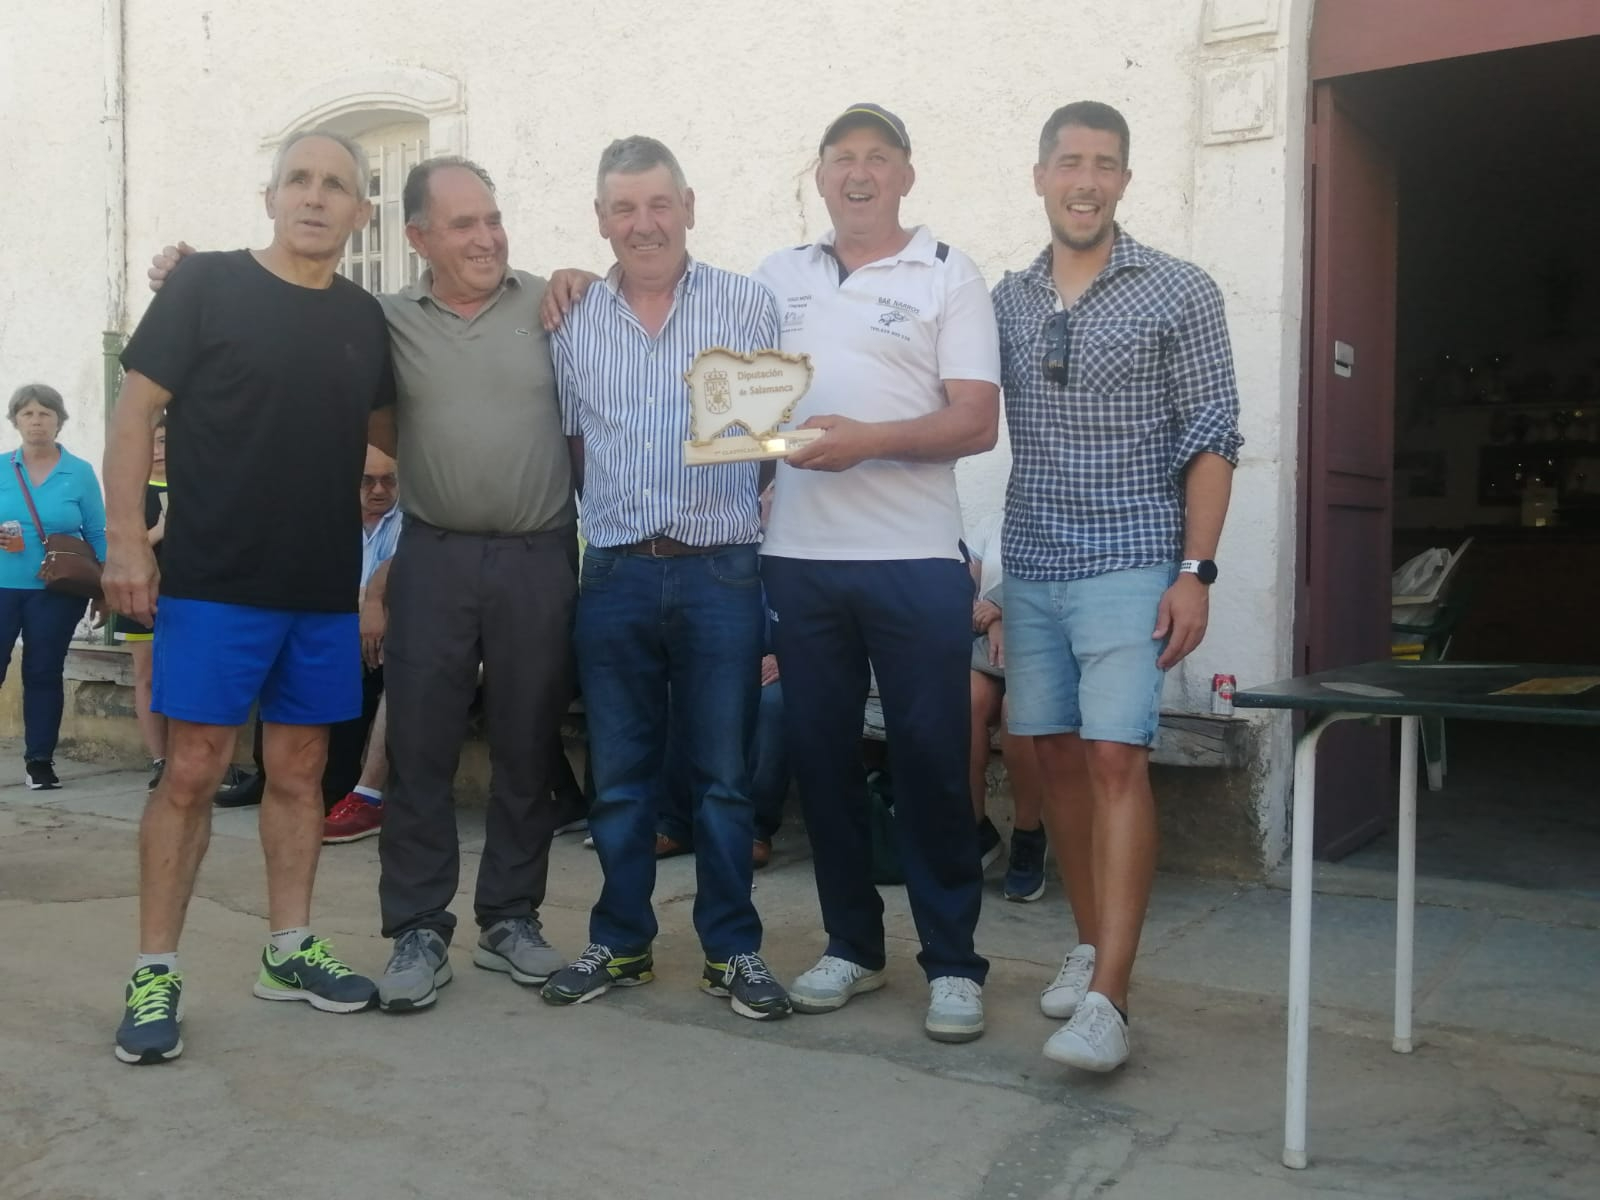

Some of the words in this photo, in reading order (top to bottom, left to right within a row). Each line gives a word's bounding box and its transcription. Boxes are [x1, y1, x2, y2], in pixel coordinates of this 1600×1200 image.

[878, 296, 891, 305] BAR
[737, 368, 784, 381] Diputación
[749, 384, 794, 395] Salamanca
